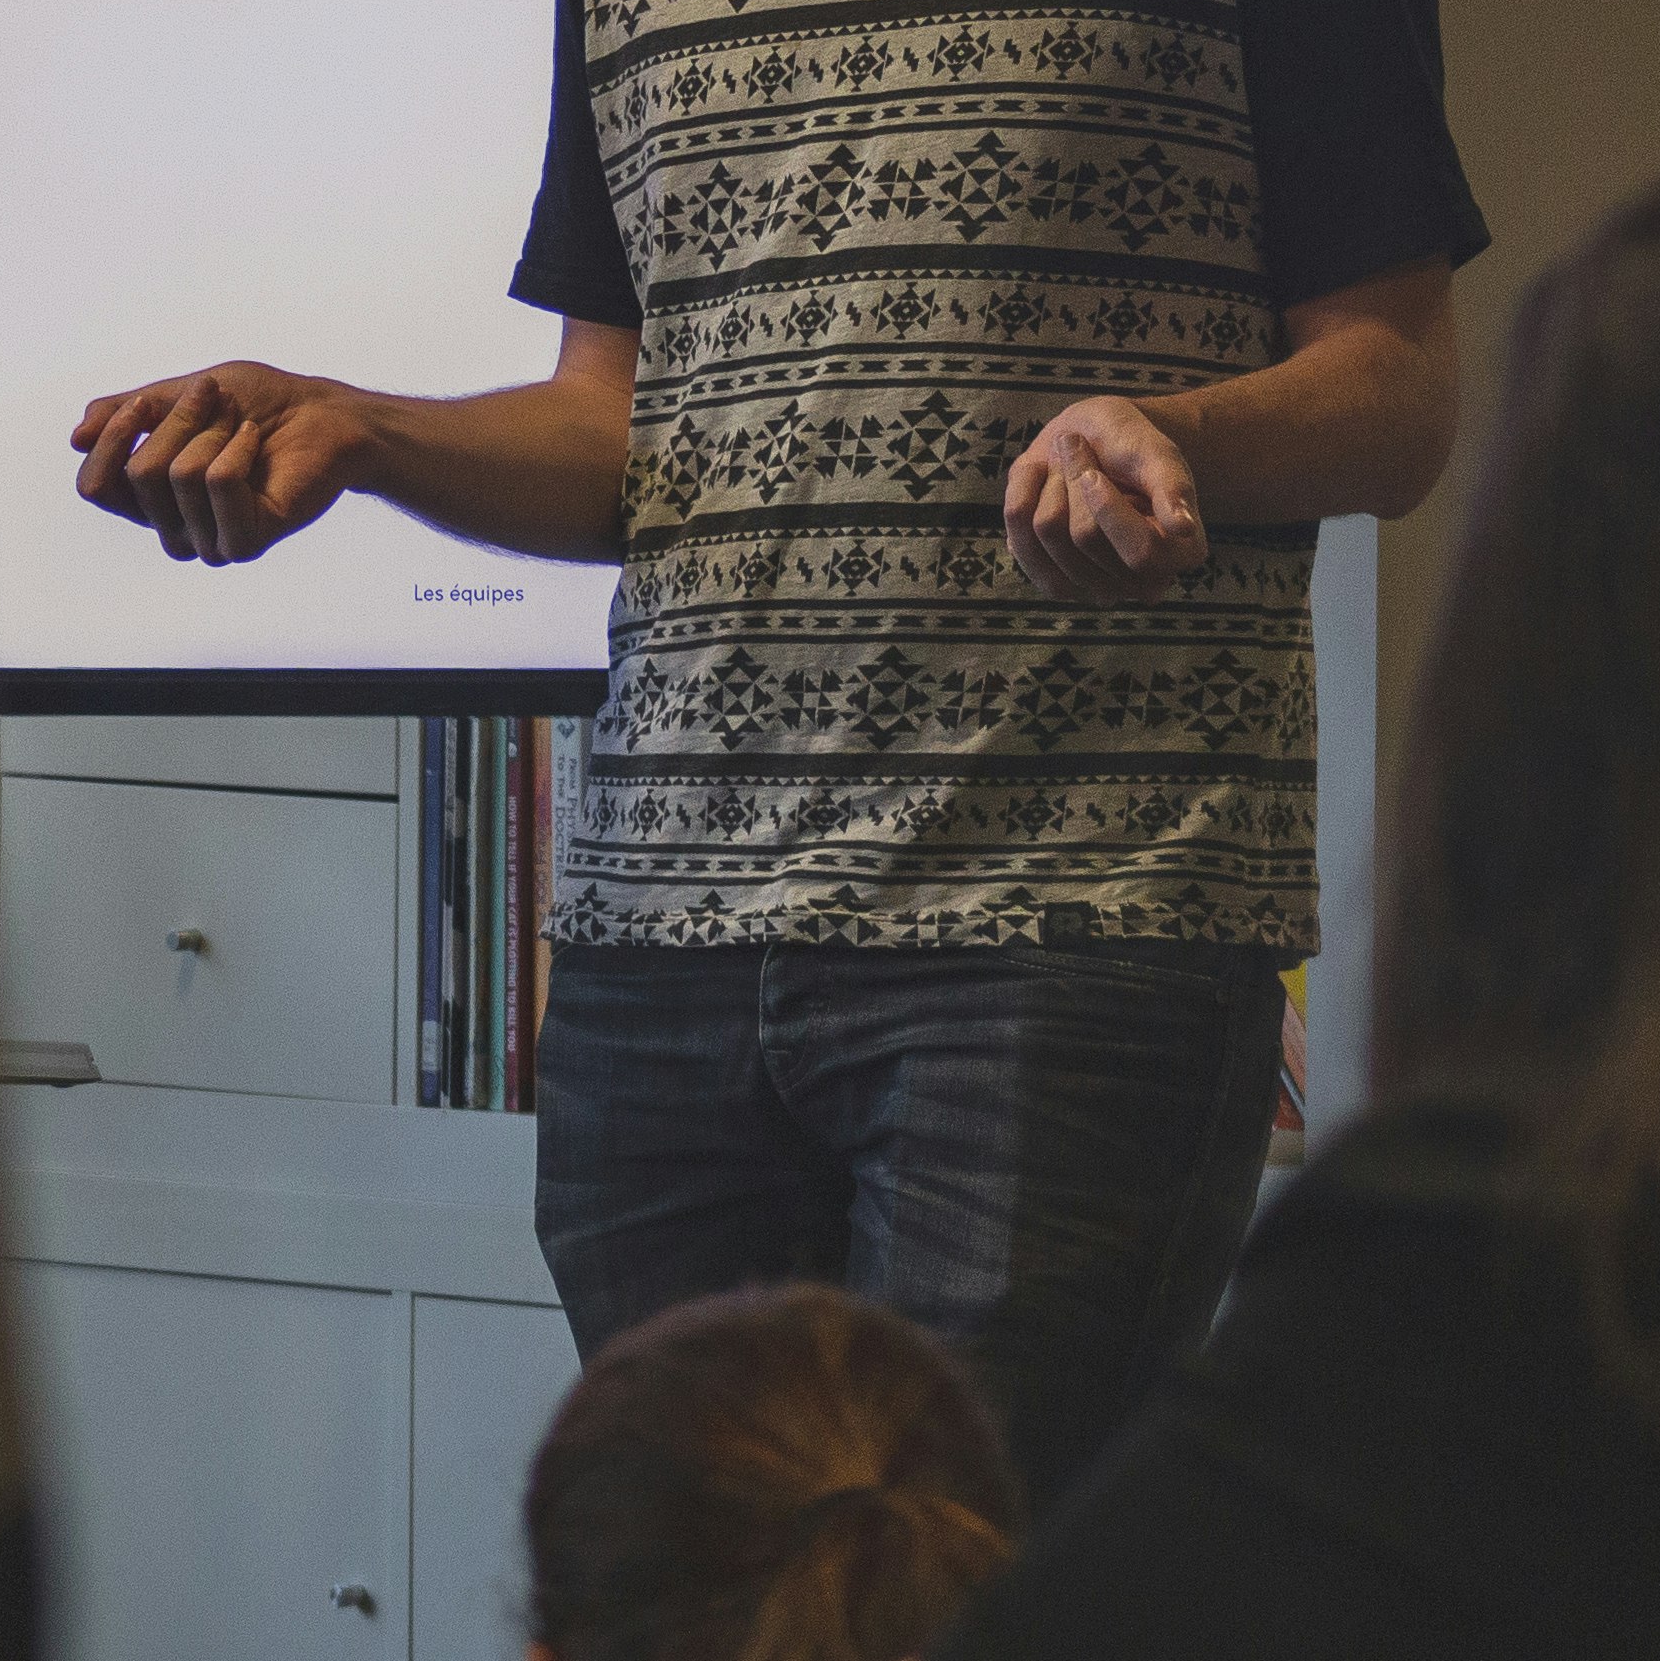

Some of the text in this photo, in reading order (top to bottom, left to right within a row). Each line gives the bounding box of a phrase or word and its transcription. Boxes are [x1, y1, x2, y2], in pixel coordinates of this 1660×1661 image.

[415, 584, 524, 605] Les équipes
[508, 795, 517, 821] HOW
[508, 824, 517, 836] TO
[508, 841, 517, 860] TELL
[508, 863, 517, 872] IF
[508, 875, 517, 904] YOUR
[507, 990, 517, 1003] TO
[507, 1006, 516, 1027] KILL
[507, 1031, 516, 1052] YOU
